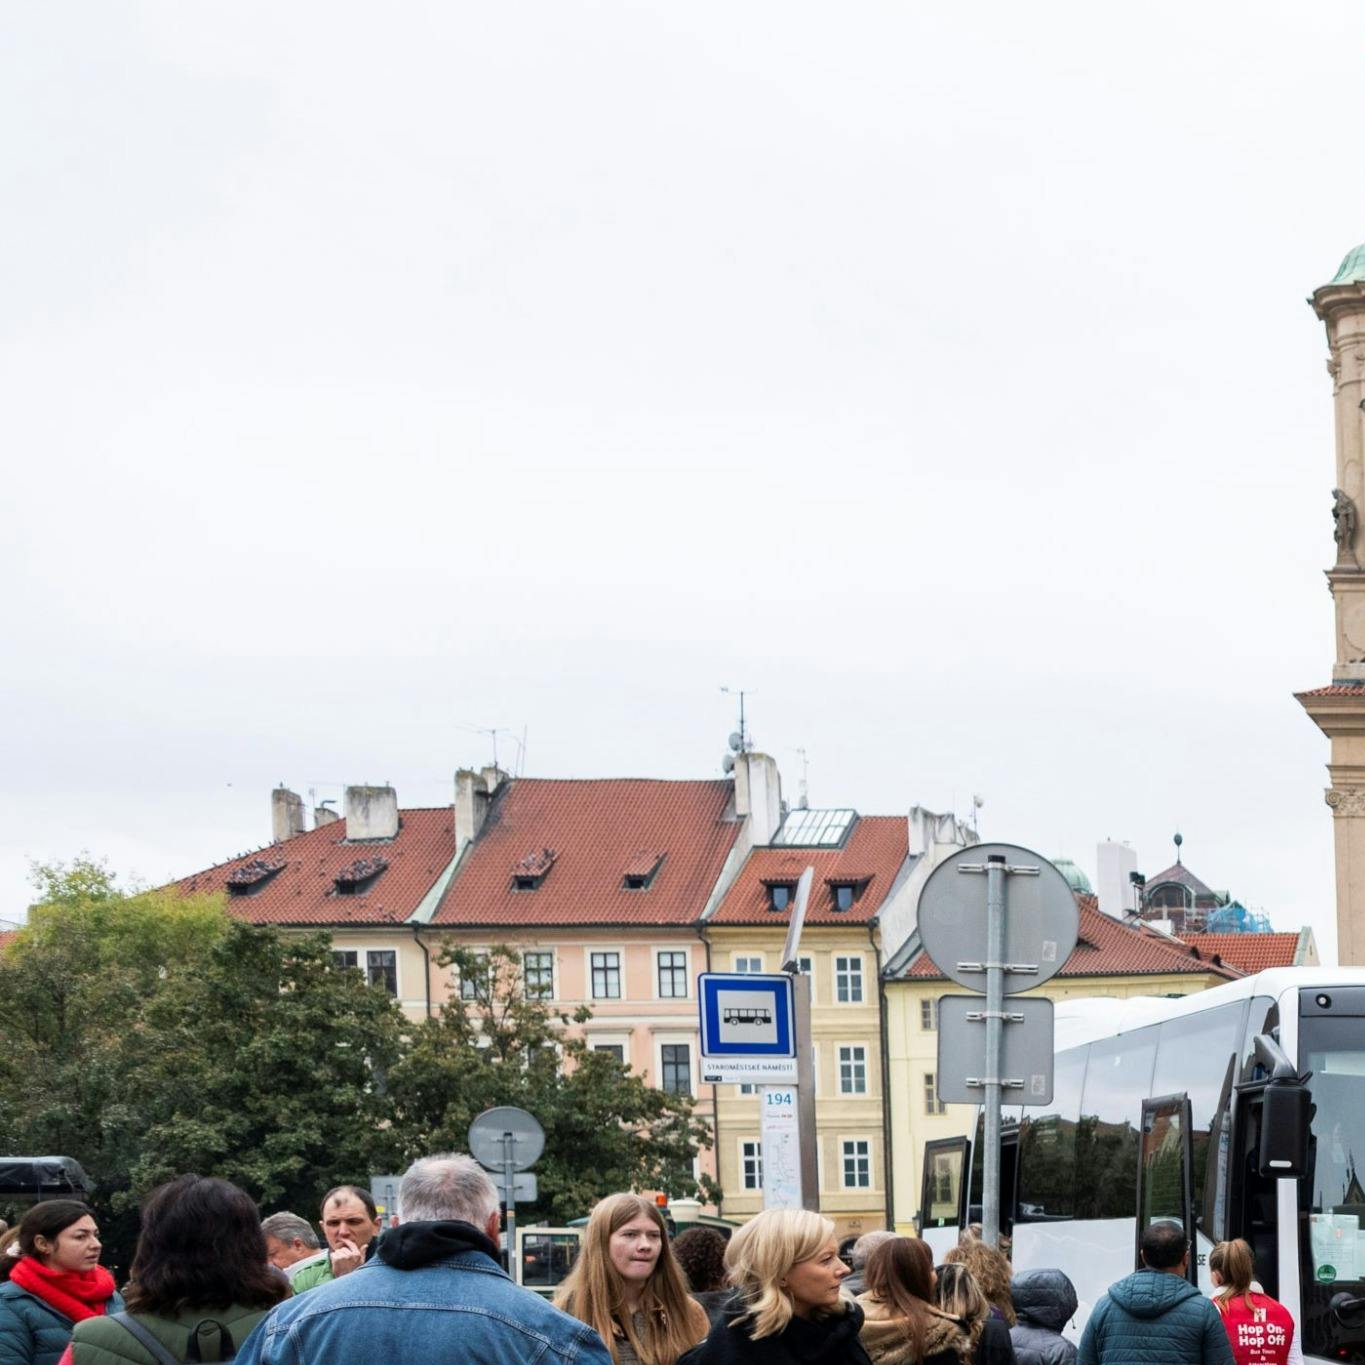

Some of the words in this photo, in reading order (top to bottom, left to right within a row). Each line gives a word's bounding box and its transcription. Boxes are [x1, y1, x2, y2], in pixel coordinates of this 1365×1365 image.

[766, 1092, 791, 1105] 194
[1238, 1324, 1264, 1336] Hop
[1266, 1323, 1285, 1334] On-
[1239, 1335, 1264, 1348] Hop
[1267, 1335, 1285, 1346] Off
